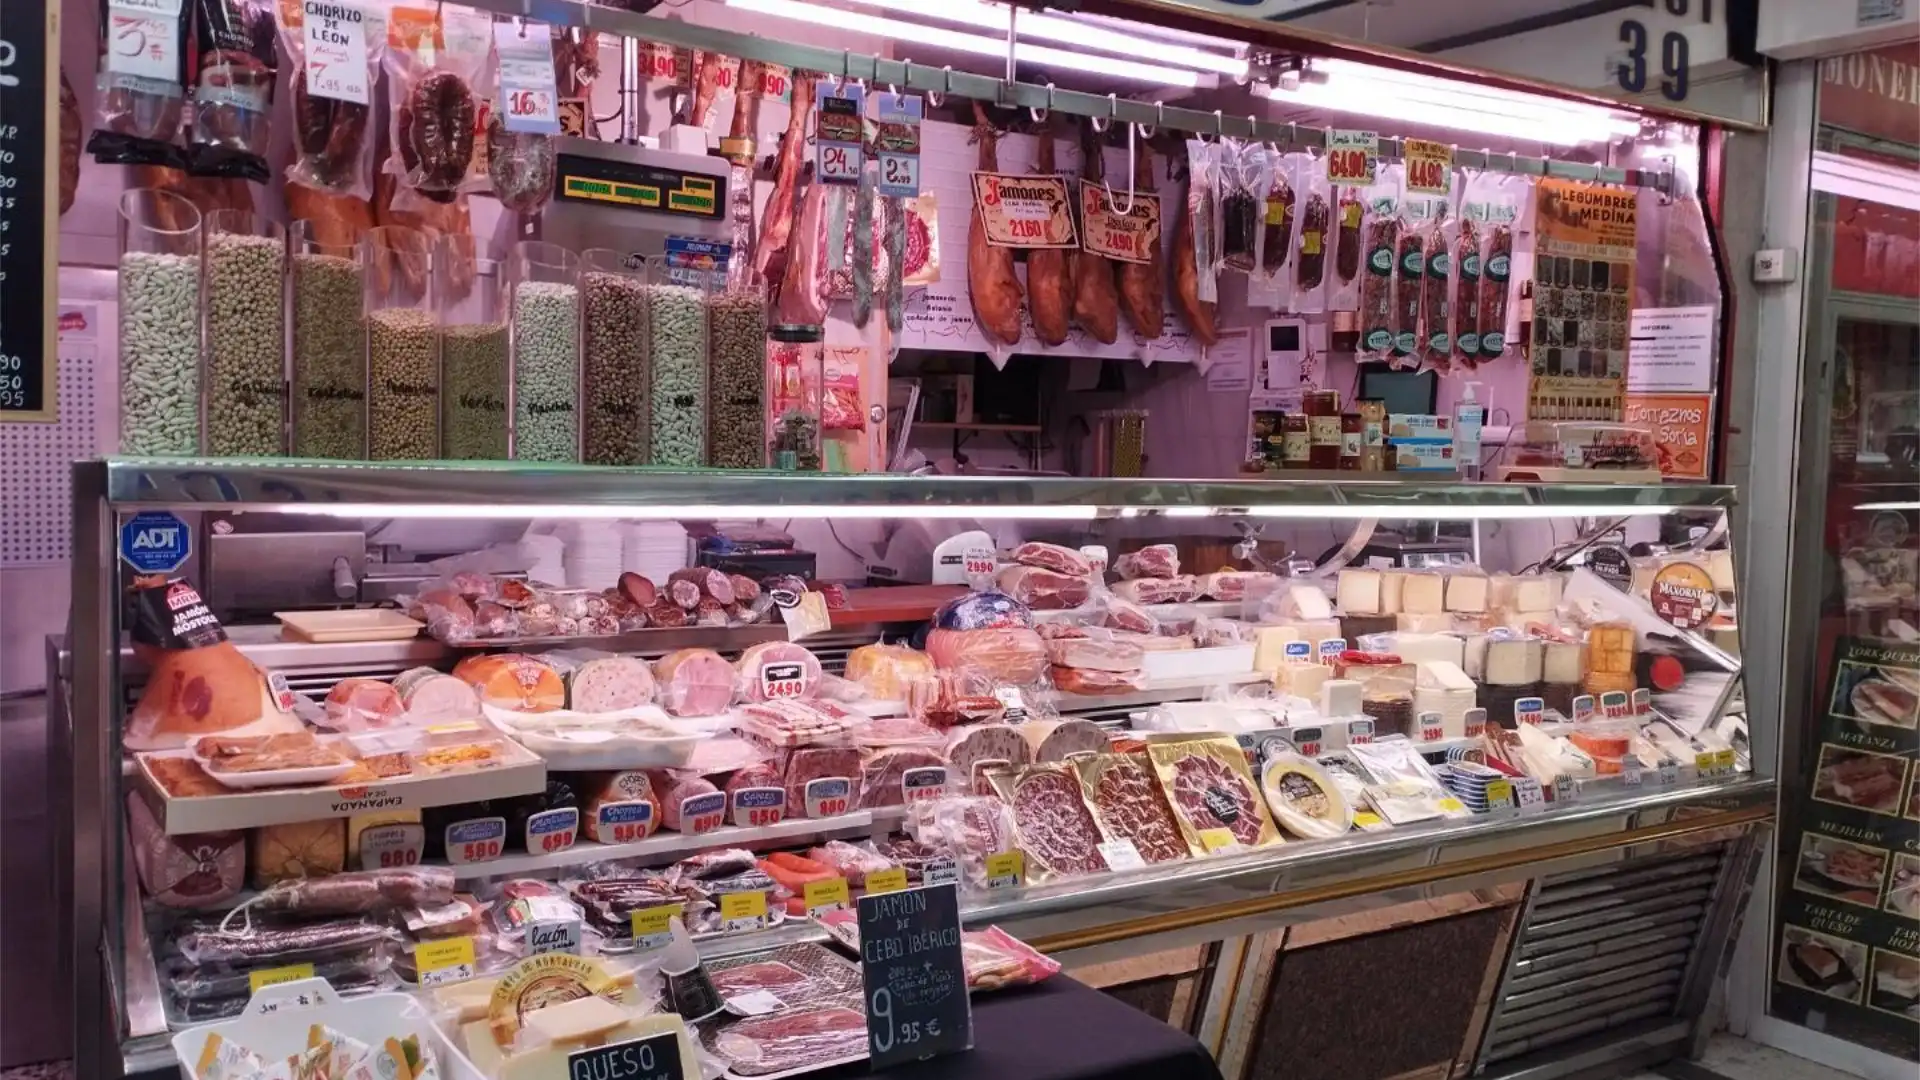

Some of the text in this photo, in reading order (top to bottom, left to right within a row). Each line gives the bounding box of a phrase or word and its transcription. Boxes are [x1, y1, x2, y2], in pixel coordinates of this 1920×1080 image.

[305, 1, 361, 23] CHORIZO
[324, 19, 338, 30] DE
[1617, 20, 1689, 102] 39
[985, 179, 1056, 206] Jamones
[1562, 189, 1636, 209] LEGUMBRES
[1580, 207, 1636, 225] MEDINA
[133, 528, 179, 549] ADT
[331, 796, 403, 812] EMPANADA
[865, 938, 902, 964] CEBO
[925, 1017, 941, 1037] €
[572, 1044, 656, 1080] QUESO
